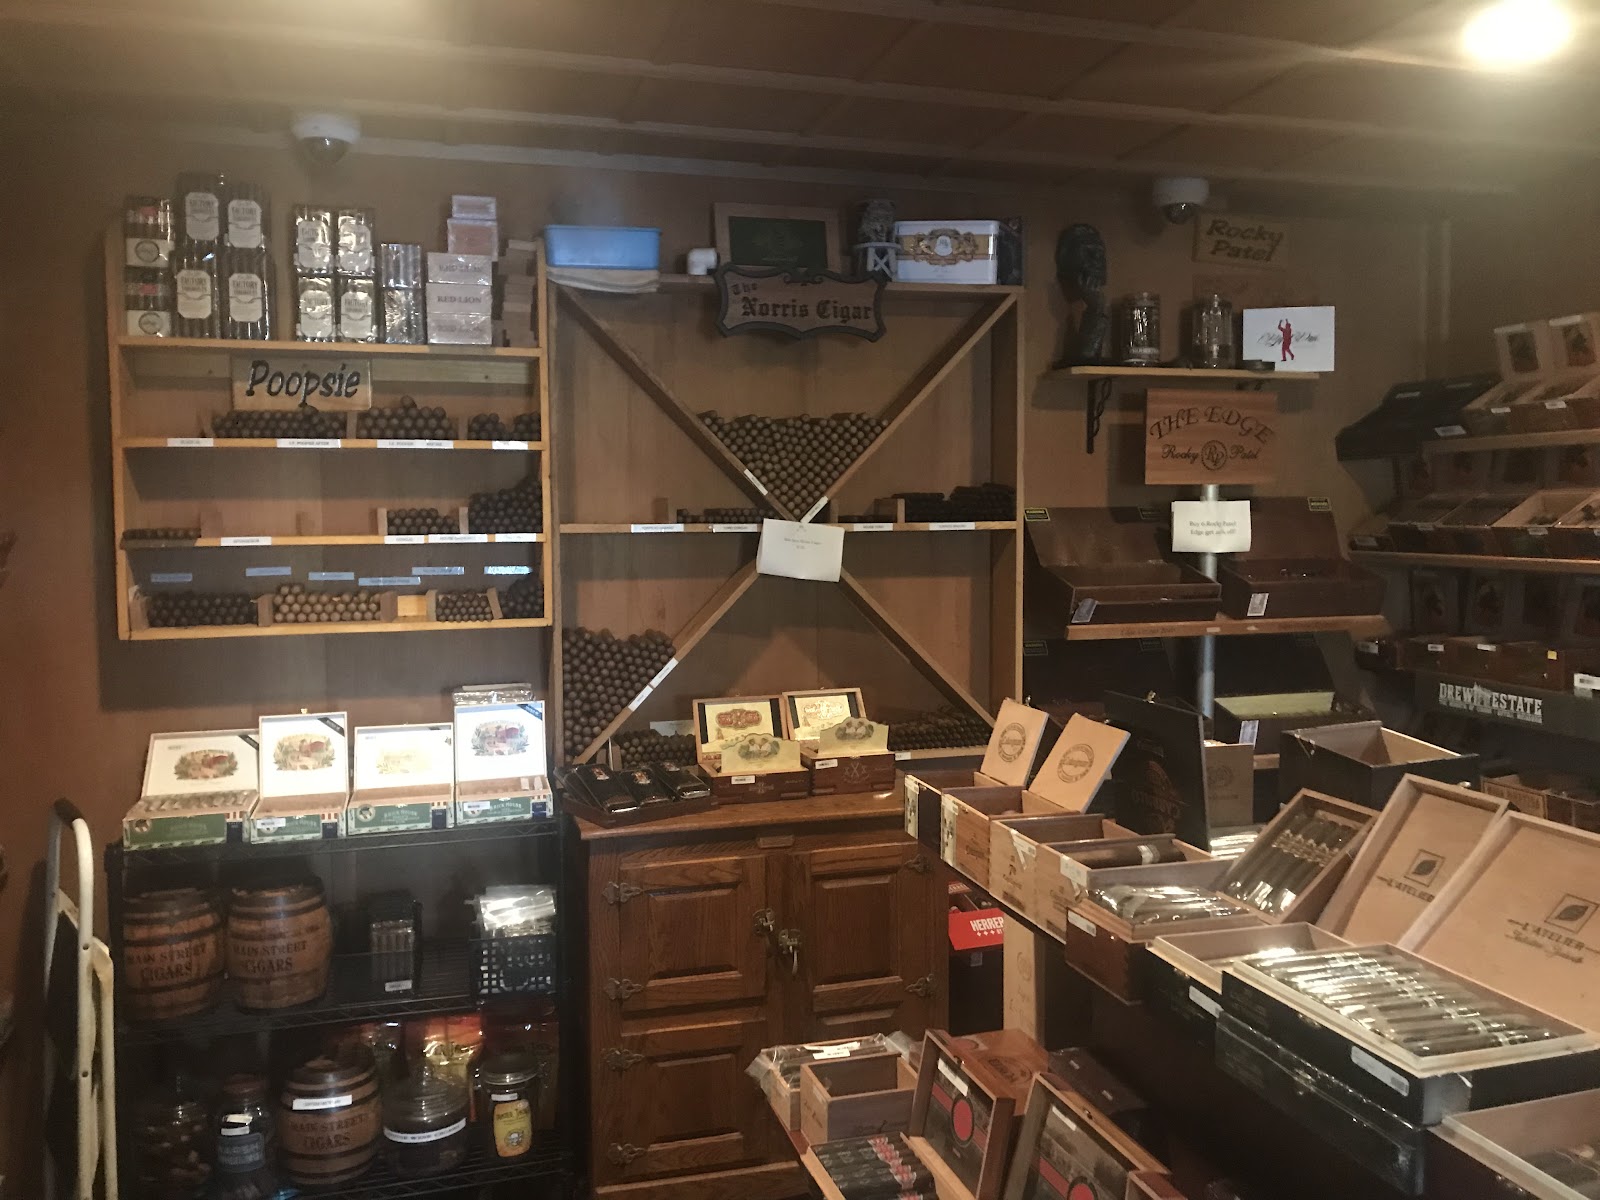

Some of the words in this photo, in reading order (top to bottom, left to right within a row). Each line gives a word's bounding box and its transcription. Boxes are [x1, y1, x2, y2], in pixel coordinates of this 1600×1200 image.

[1206, 219, 1284, 246] Rocky
[1210, 239, 1279, 262] Patel
[730, 282, 758, 296] The
[741, 296, 809, 318] Norris
[816, 300, 873, 324] Cigar
[245, 359, 361, 408] Poopsie
[1149, 407, 1200, 440] THE
[1204, 406, 1275, 444] EDGE
[1161, 443, 1200, 465] Rocky
[1229, 443, 1261, 460] Patel
[1439, 682, 1475, 705] DREW
[1491, 691, 1543, 716] ESTATE
[262, 939, 308, 956] STREET
[1521, 921, 1586, 951] L'ATELIER
[159, 942, 207, 961] STREET
[139, 961, 193, 983] CIGARS
[246, 957, 293, 975] CIGARS
